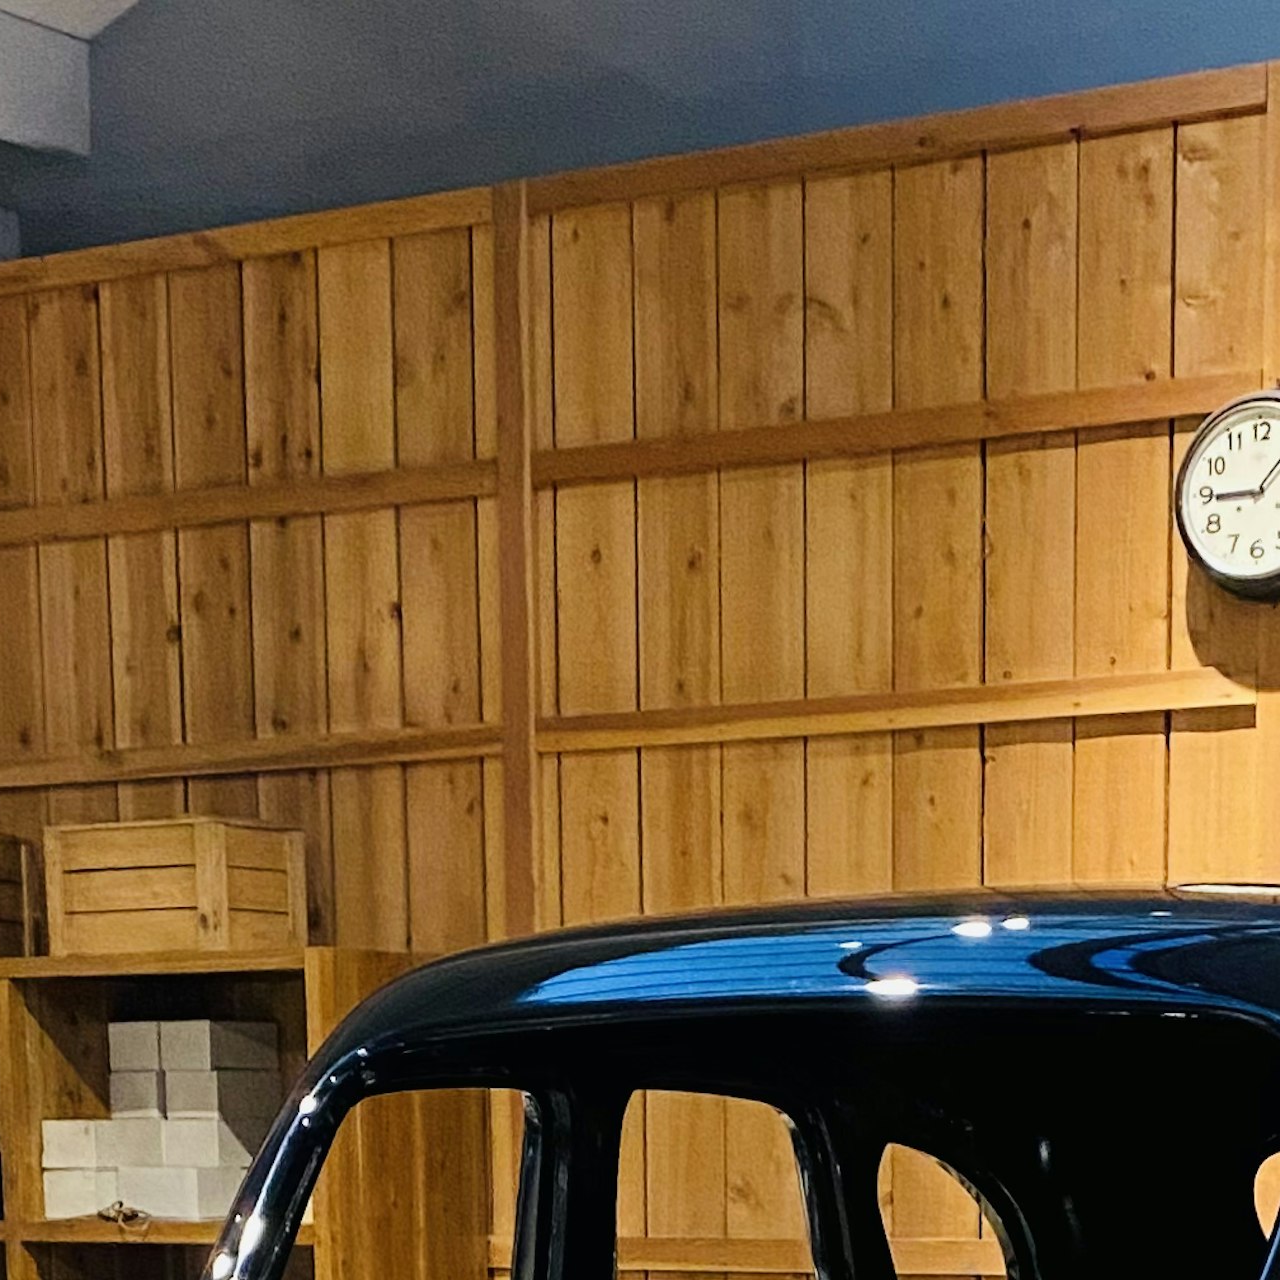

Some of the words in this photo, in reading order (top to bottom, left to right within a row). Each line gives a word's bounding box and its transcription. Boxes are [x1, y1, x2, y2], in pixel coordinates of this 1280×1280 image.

[1227, 431, 1242, 451] 11
[1253, 422, 1271, 441] 12
[1208, 456, 1225, 476] 10
[1199, 486, 1214, 505] 9
[1206, 513, 1221, 534] 8
[1228, 534, 1240, 555] 7
[1250, 540, 1264, 559] 6
